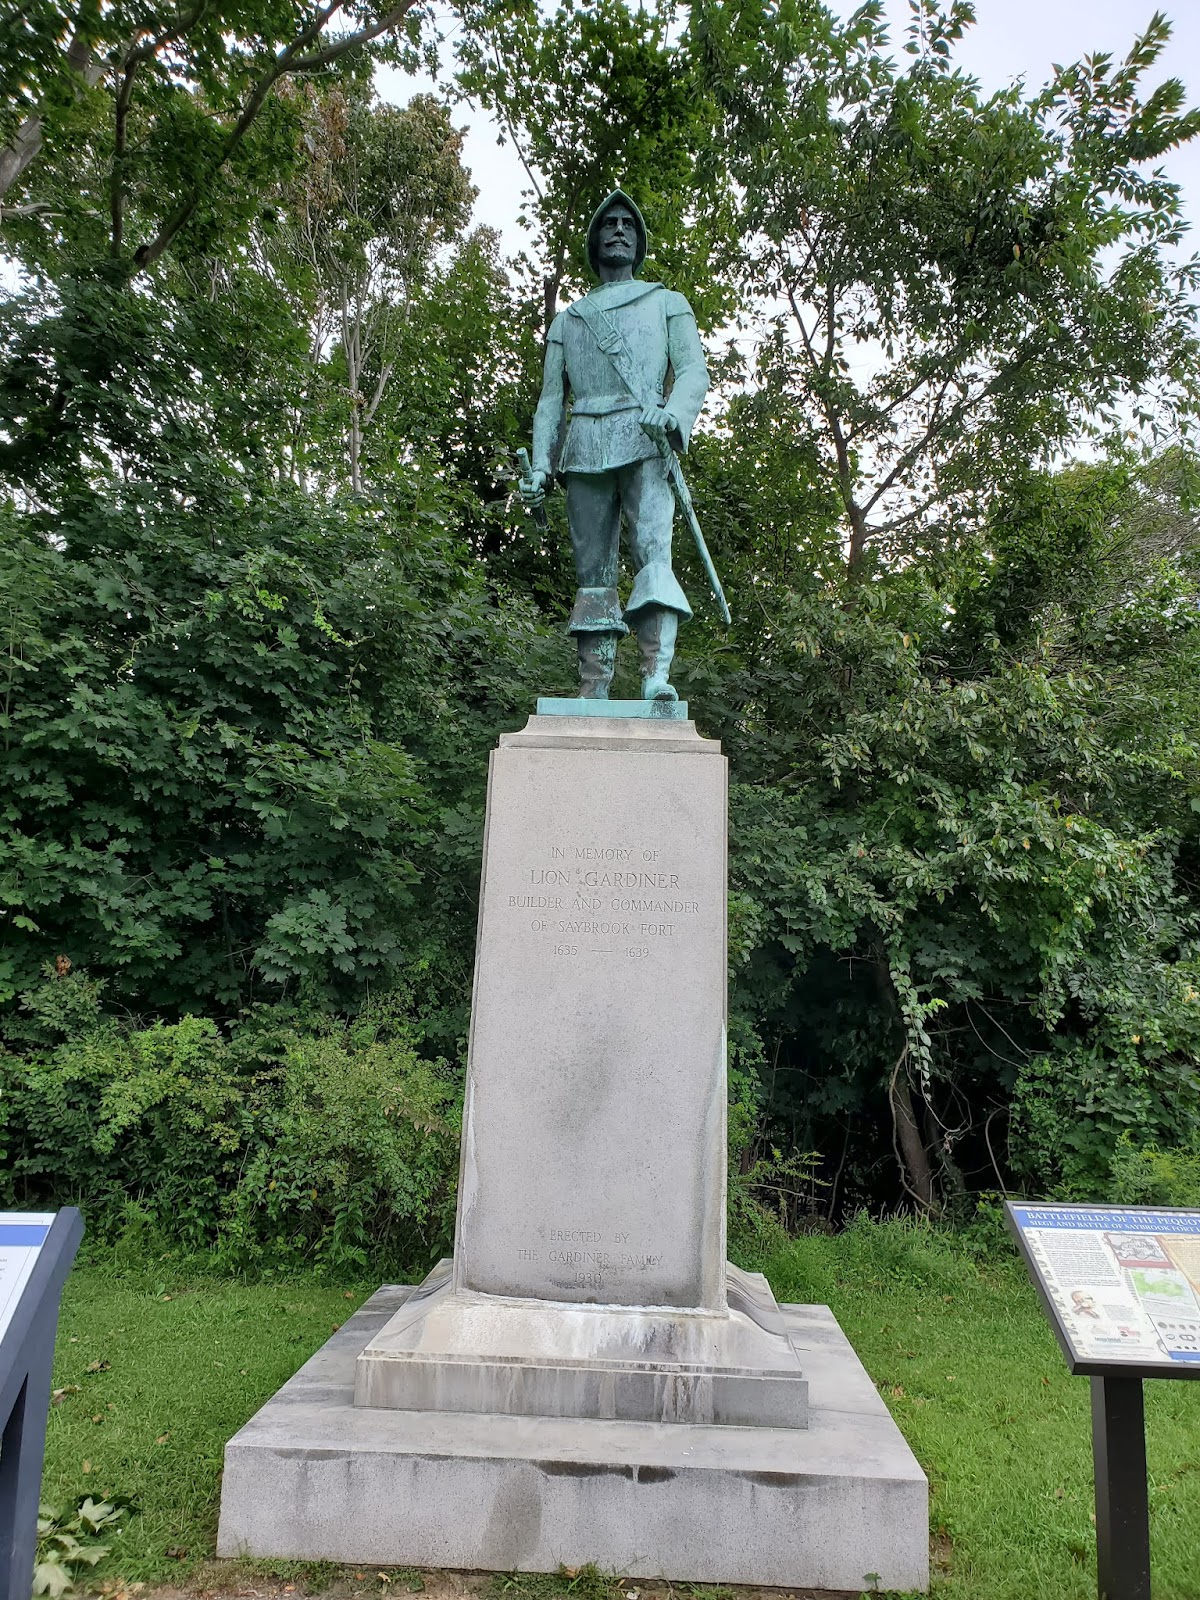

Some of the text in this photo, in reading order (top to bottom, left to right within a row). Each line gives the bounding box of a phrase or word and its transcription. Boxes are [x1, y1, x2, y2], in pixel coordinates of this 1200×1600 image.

[551, 847, 660, 861] IN MEMORY OF
[530, 870, 680, 889] LION GARDINER
[509, 896, 700, 913] BUILDER AND COMMANDER
[531, 920, 675, 936] OF SAYBROOK FORT
[553, 945, 577, 956] 1635
[625, 947, 649, 958] 1639
[1027, 1212, 1110, 1222] BATTLEFIELDS
[1112, 1215, 1128, 1223] OF
[1129, 1216, 1156, 1224] THE
[550, 1229, 630, 1244] ERECTED BY
[518, 1250, 538, 1260] THE
[549, 1251, 610, 1264] GARDINER
